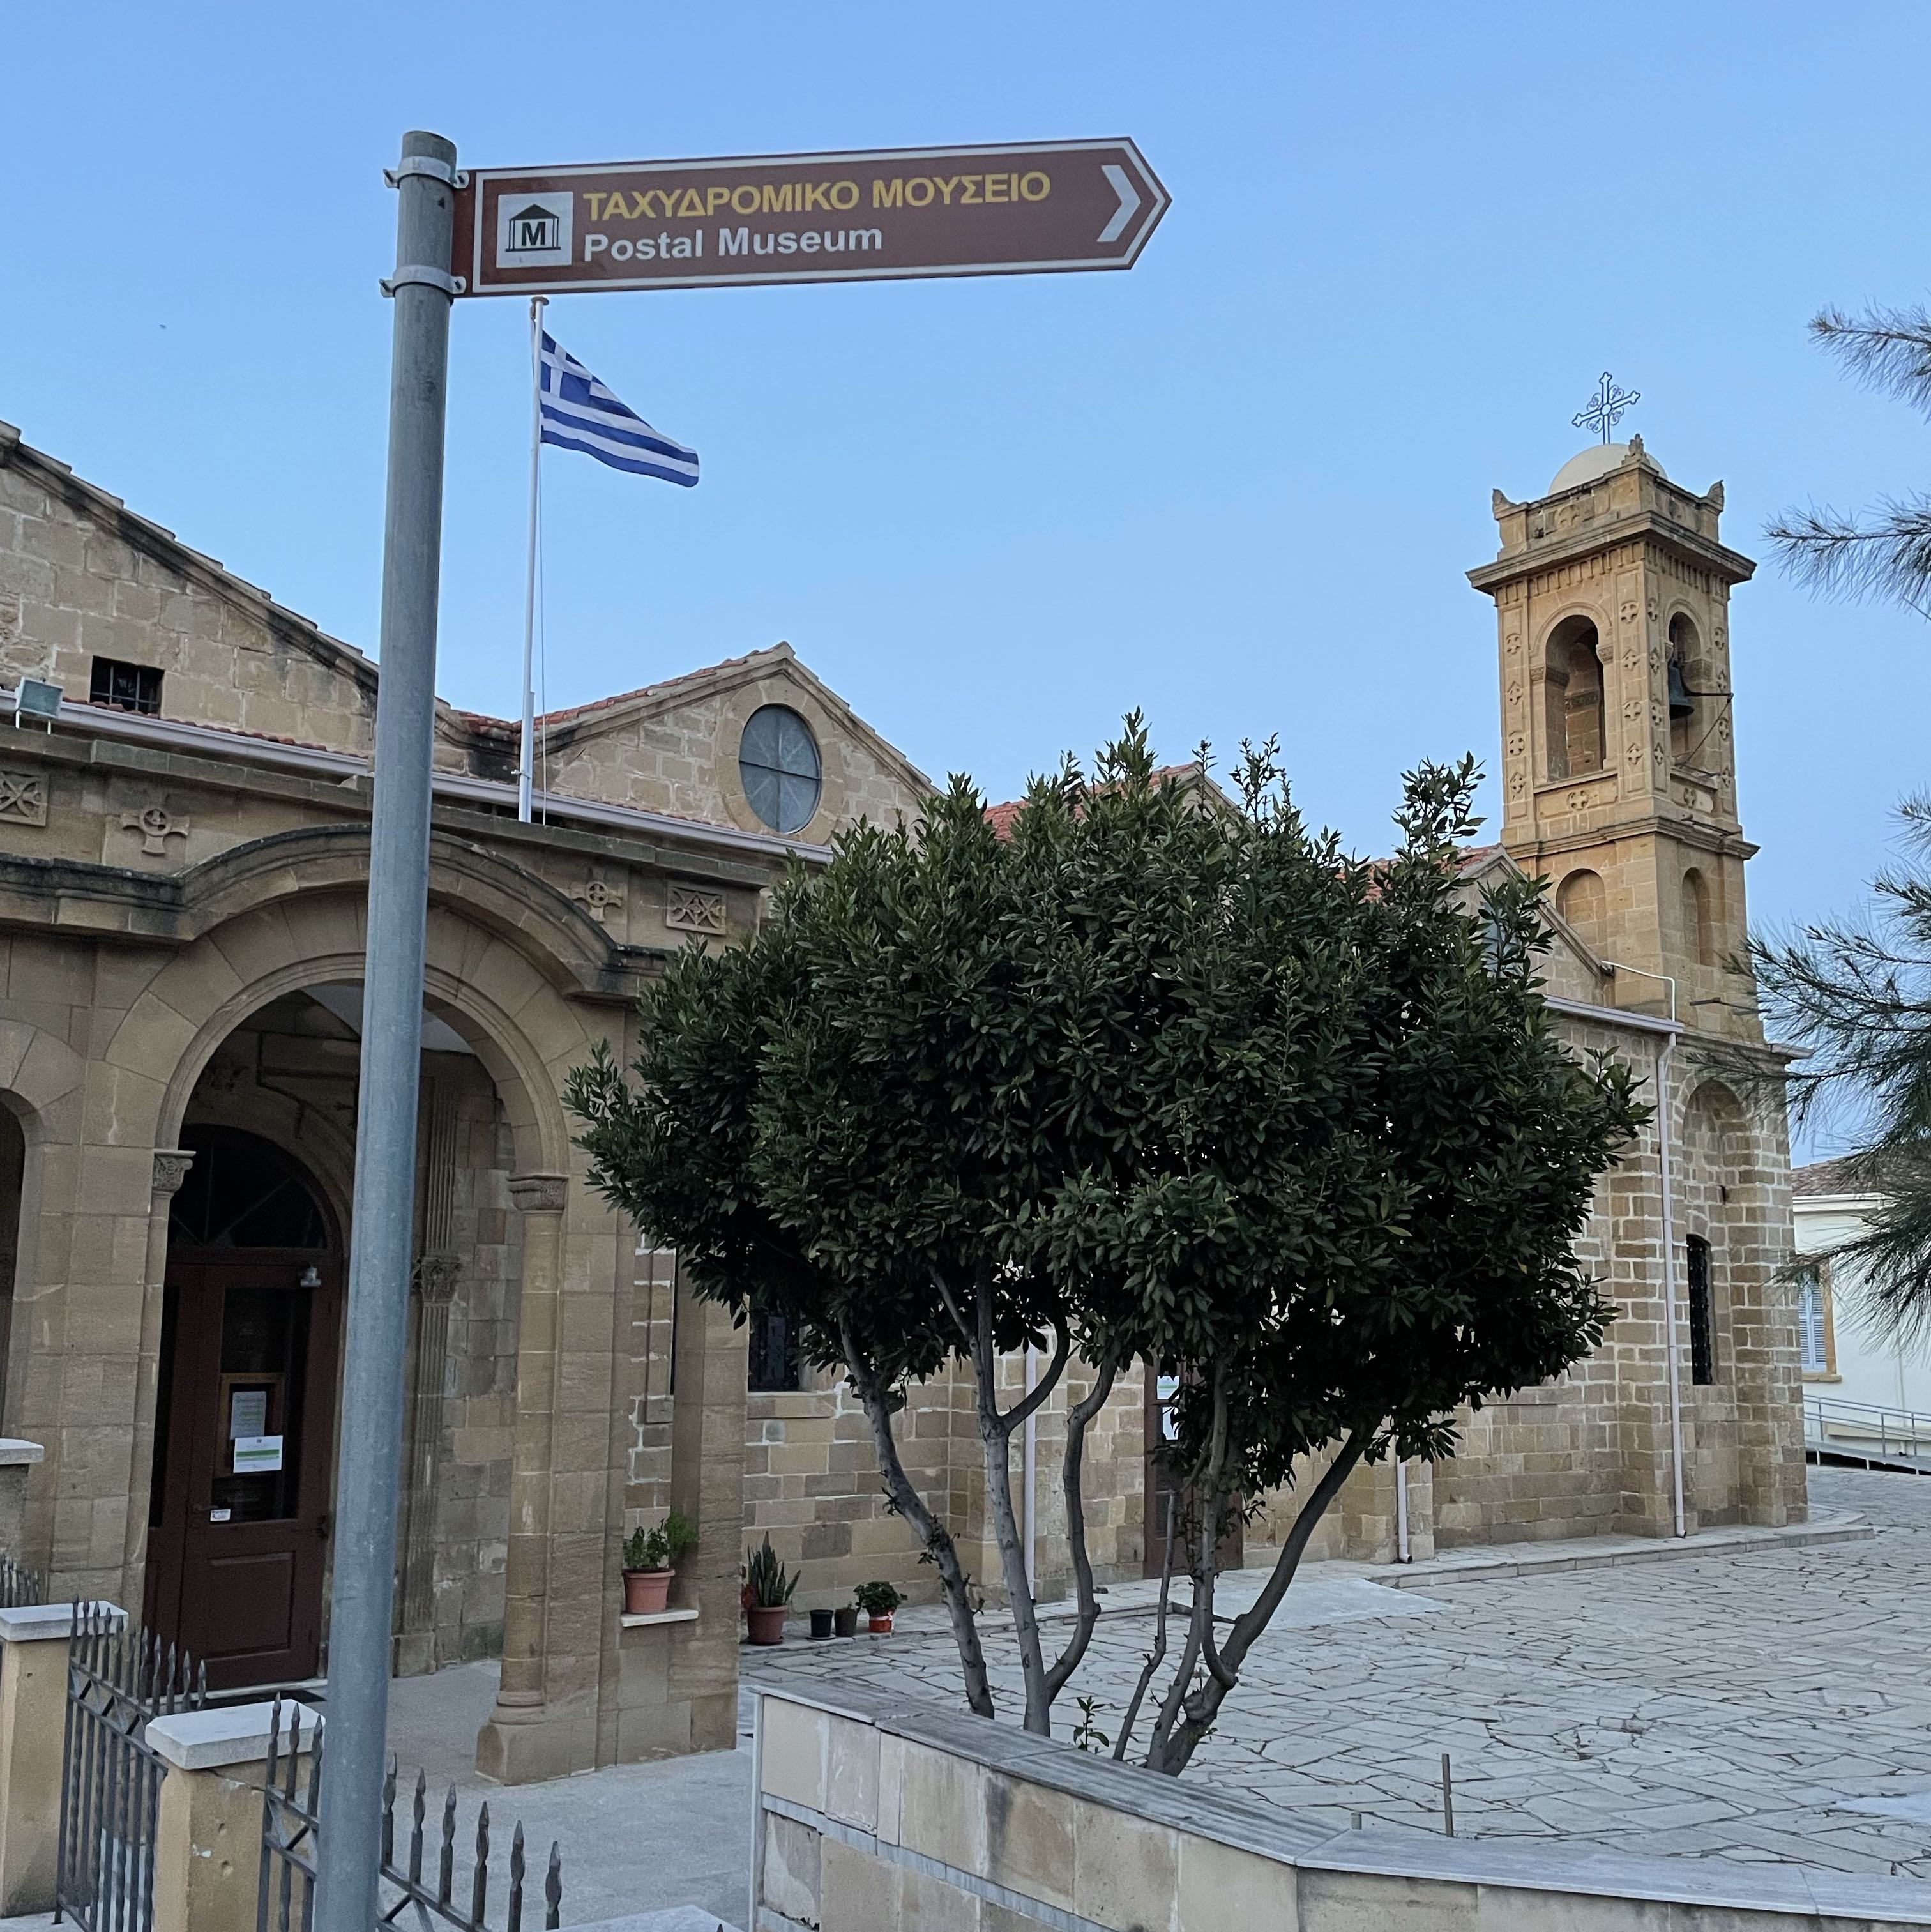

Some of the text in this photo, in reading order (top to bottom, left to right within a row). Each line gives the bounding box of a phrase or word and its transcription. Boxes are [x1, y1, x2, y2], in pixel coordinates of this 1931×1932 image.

[582, 171, 1050, 221] ΤΑΧΥΔΡΟΜΙΚΟ ΜΟΥΣΕΙΟ
[521, 221, 546, 247] M
[584, 226, 882, 262] Postal Museum
